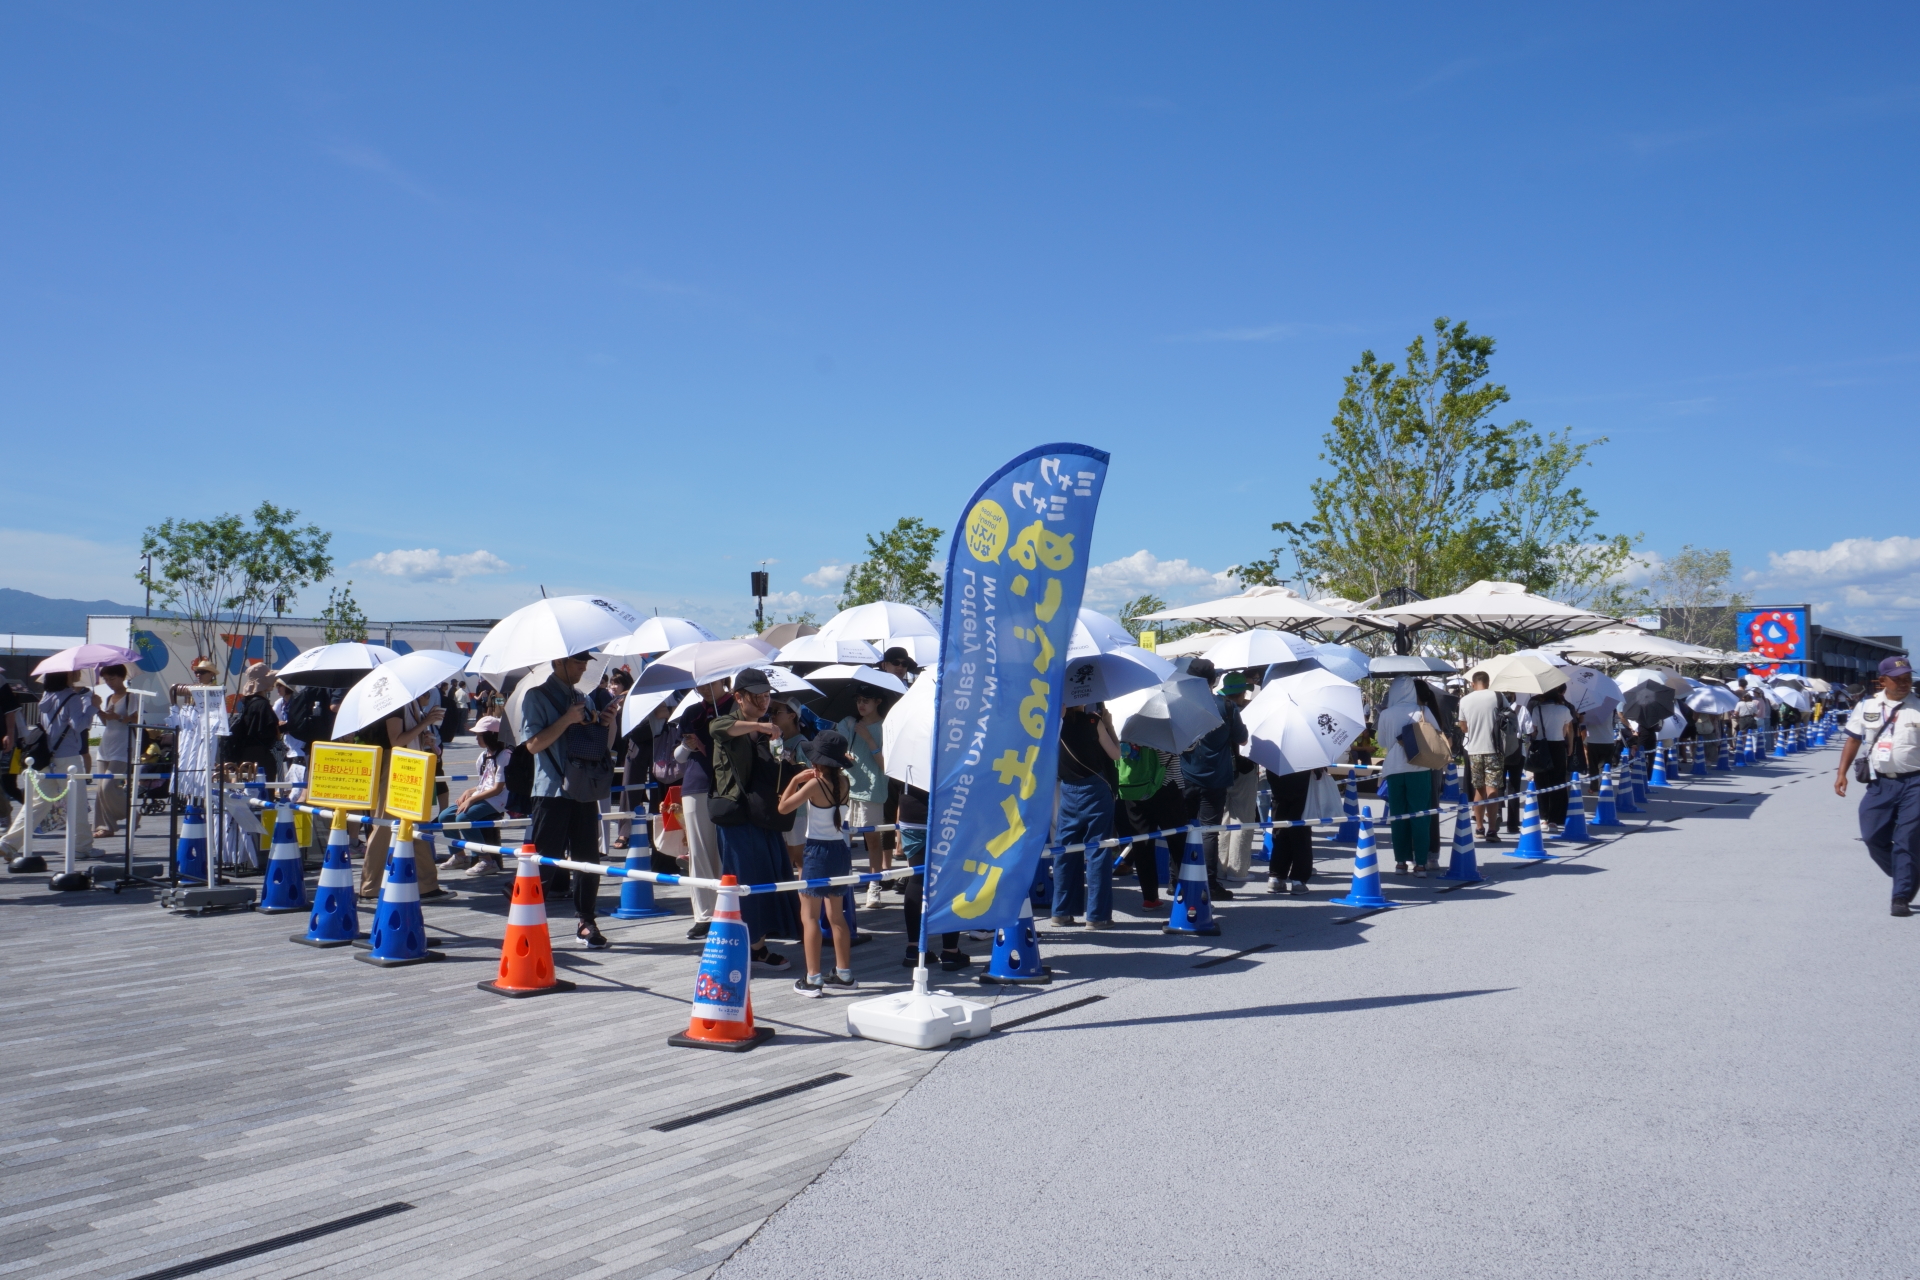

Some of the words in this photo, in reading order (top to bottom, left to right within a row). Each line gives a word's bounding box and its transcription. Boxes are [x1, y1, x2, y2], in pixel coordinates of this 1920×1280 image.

[1071, 688, 1093, 696] OFFICIAL
[1073, 692, 1090, 700] STORE
[1332, 729, 1348, 745] OFFICIAL
[1337, 733, 1349, 746] STORE
